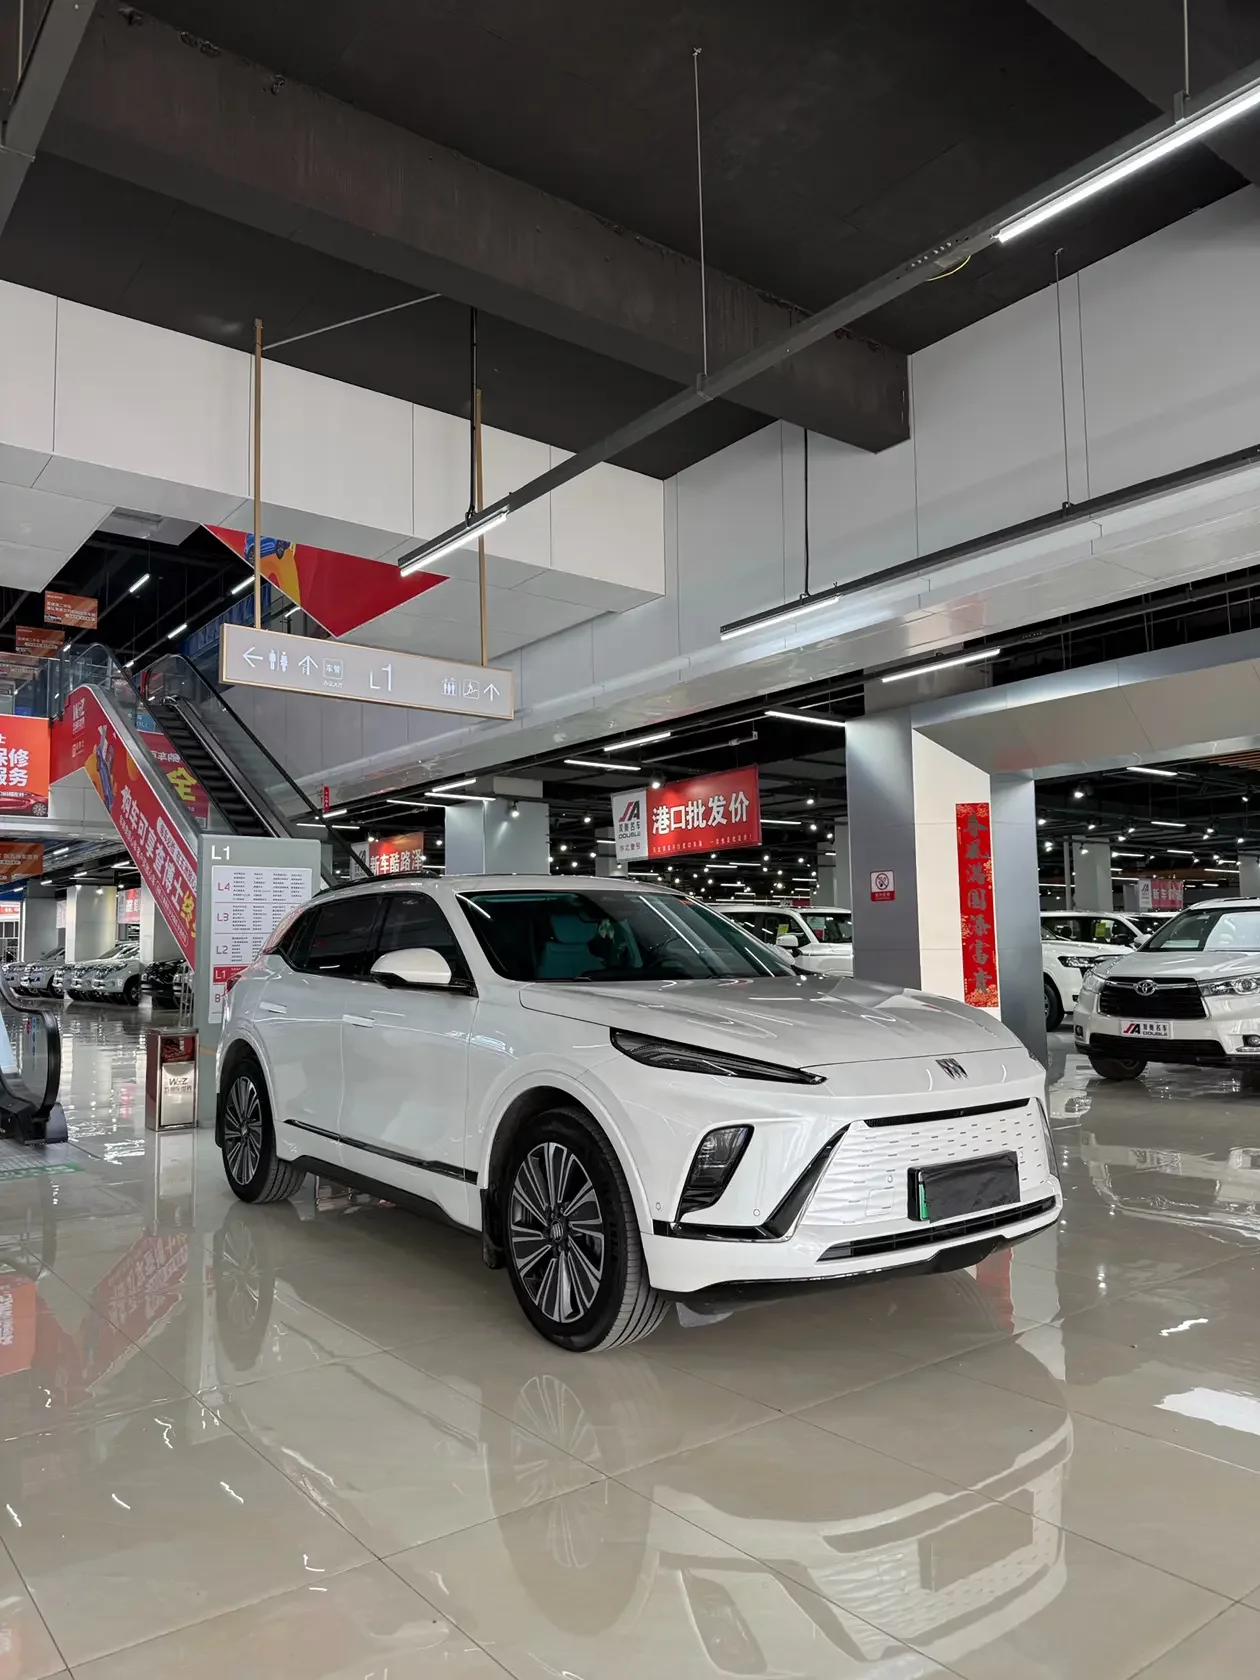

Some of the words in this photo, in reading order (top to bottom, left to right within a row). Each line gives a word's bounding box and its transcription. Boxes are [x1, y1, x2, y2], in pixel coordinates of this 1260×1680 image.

[369, 663, 392, 691] L1
[652, 790, 750, 835] 港口批发价
[211, 845, 230, 860] L1
[370, 848, 422, 876] 新车酷路泽
[217, 882, 231, 891] L4
[217, 912, 229, 922] L3
[216, 945, 229, 955] L2
[215, 969, 226, 979] L1
